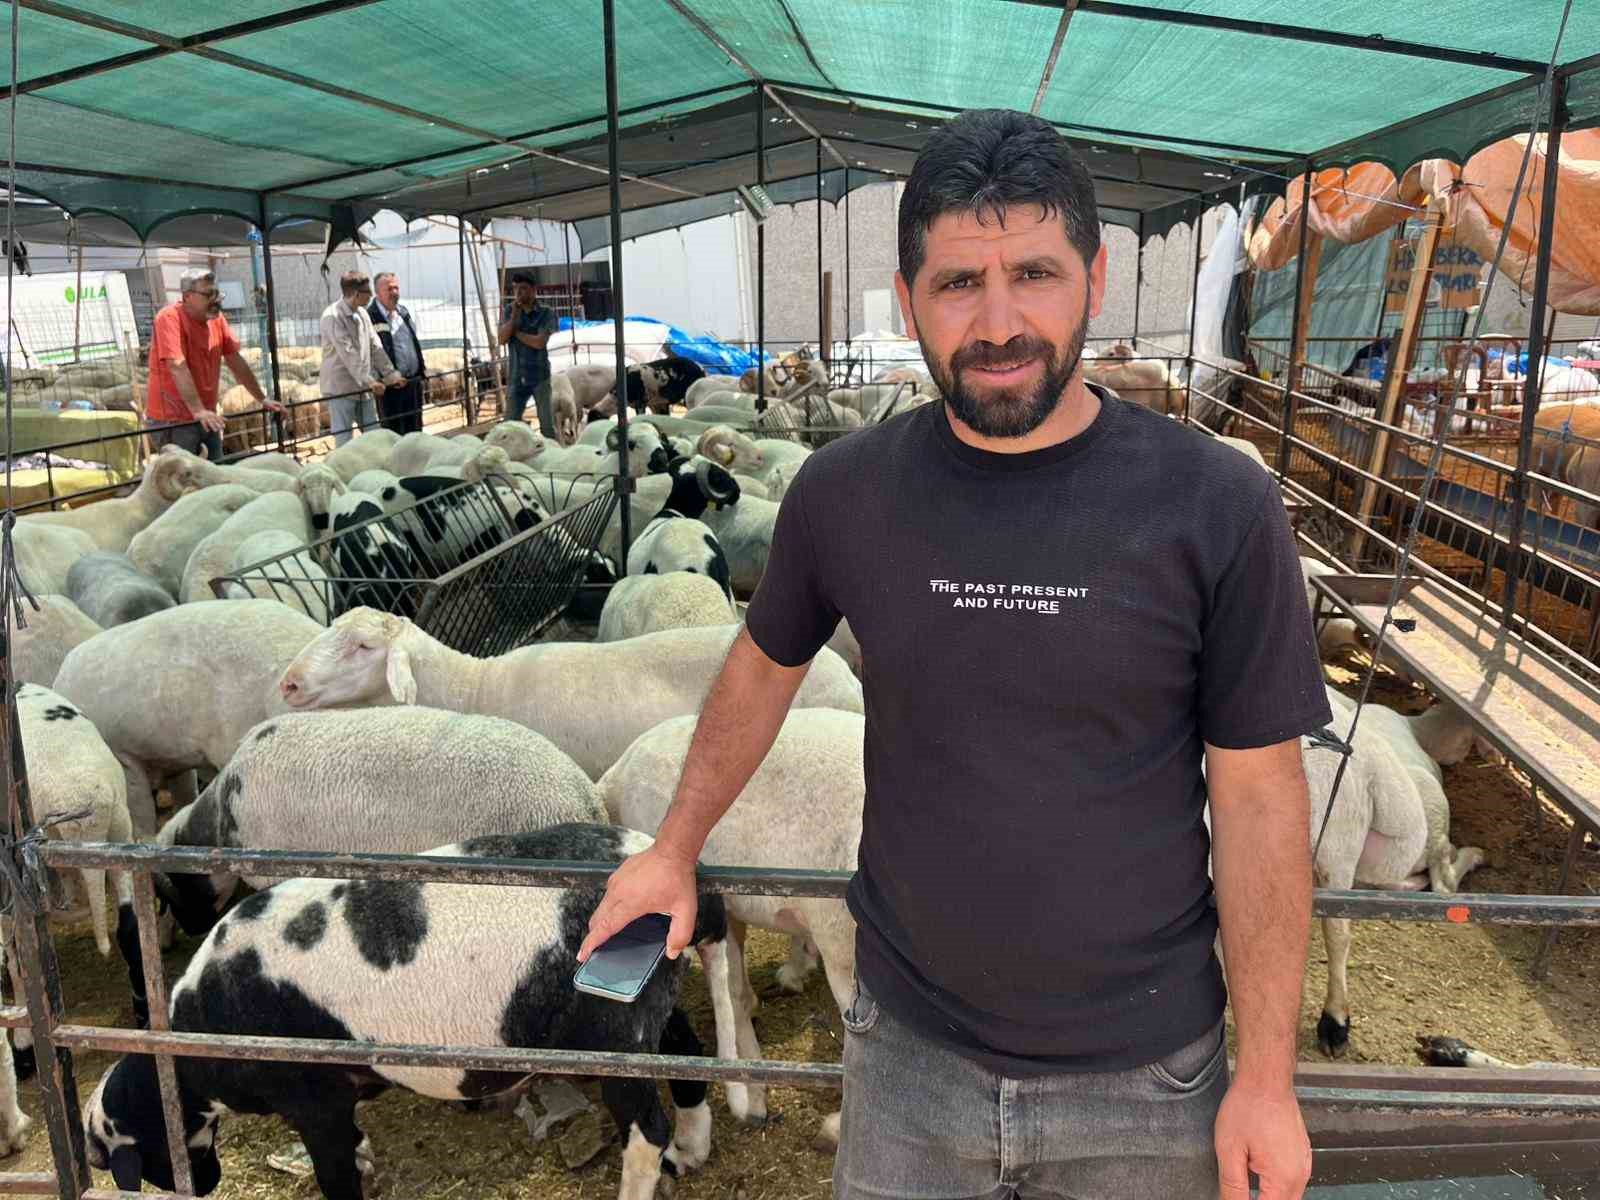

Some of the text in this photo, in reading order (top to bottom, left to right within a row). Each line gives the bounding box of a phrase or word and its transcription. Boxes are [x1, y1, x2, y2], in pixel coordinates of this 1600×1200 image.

[929, 581, 1089, 598] THE PAST PRESENT
[952, 597, 1060, 612] AND FUTURE
